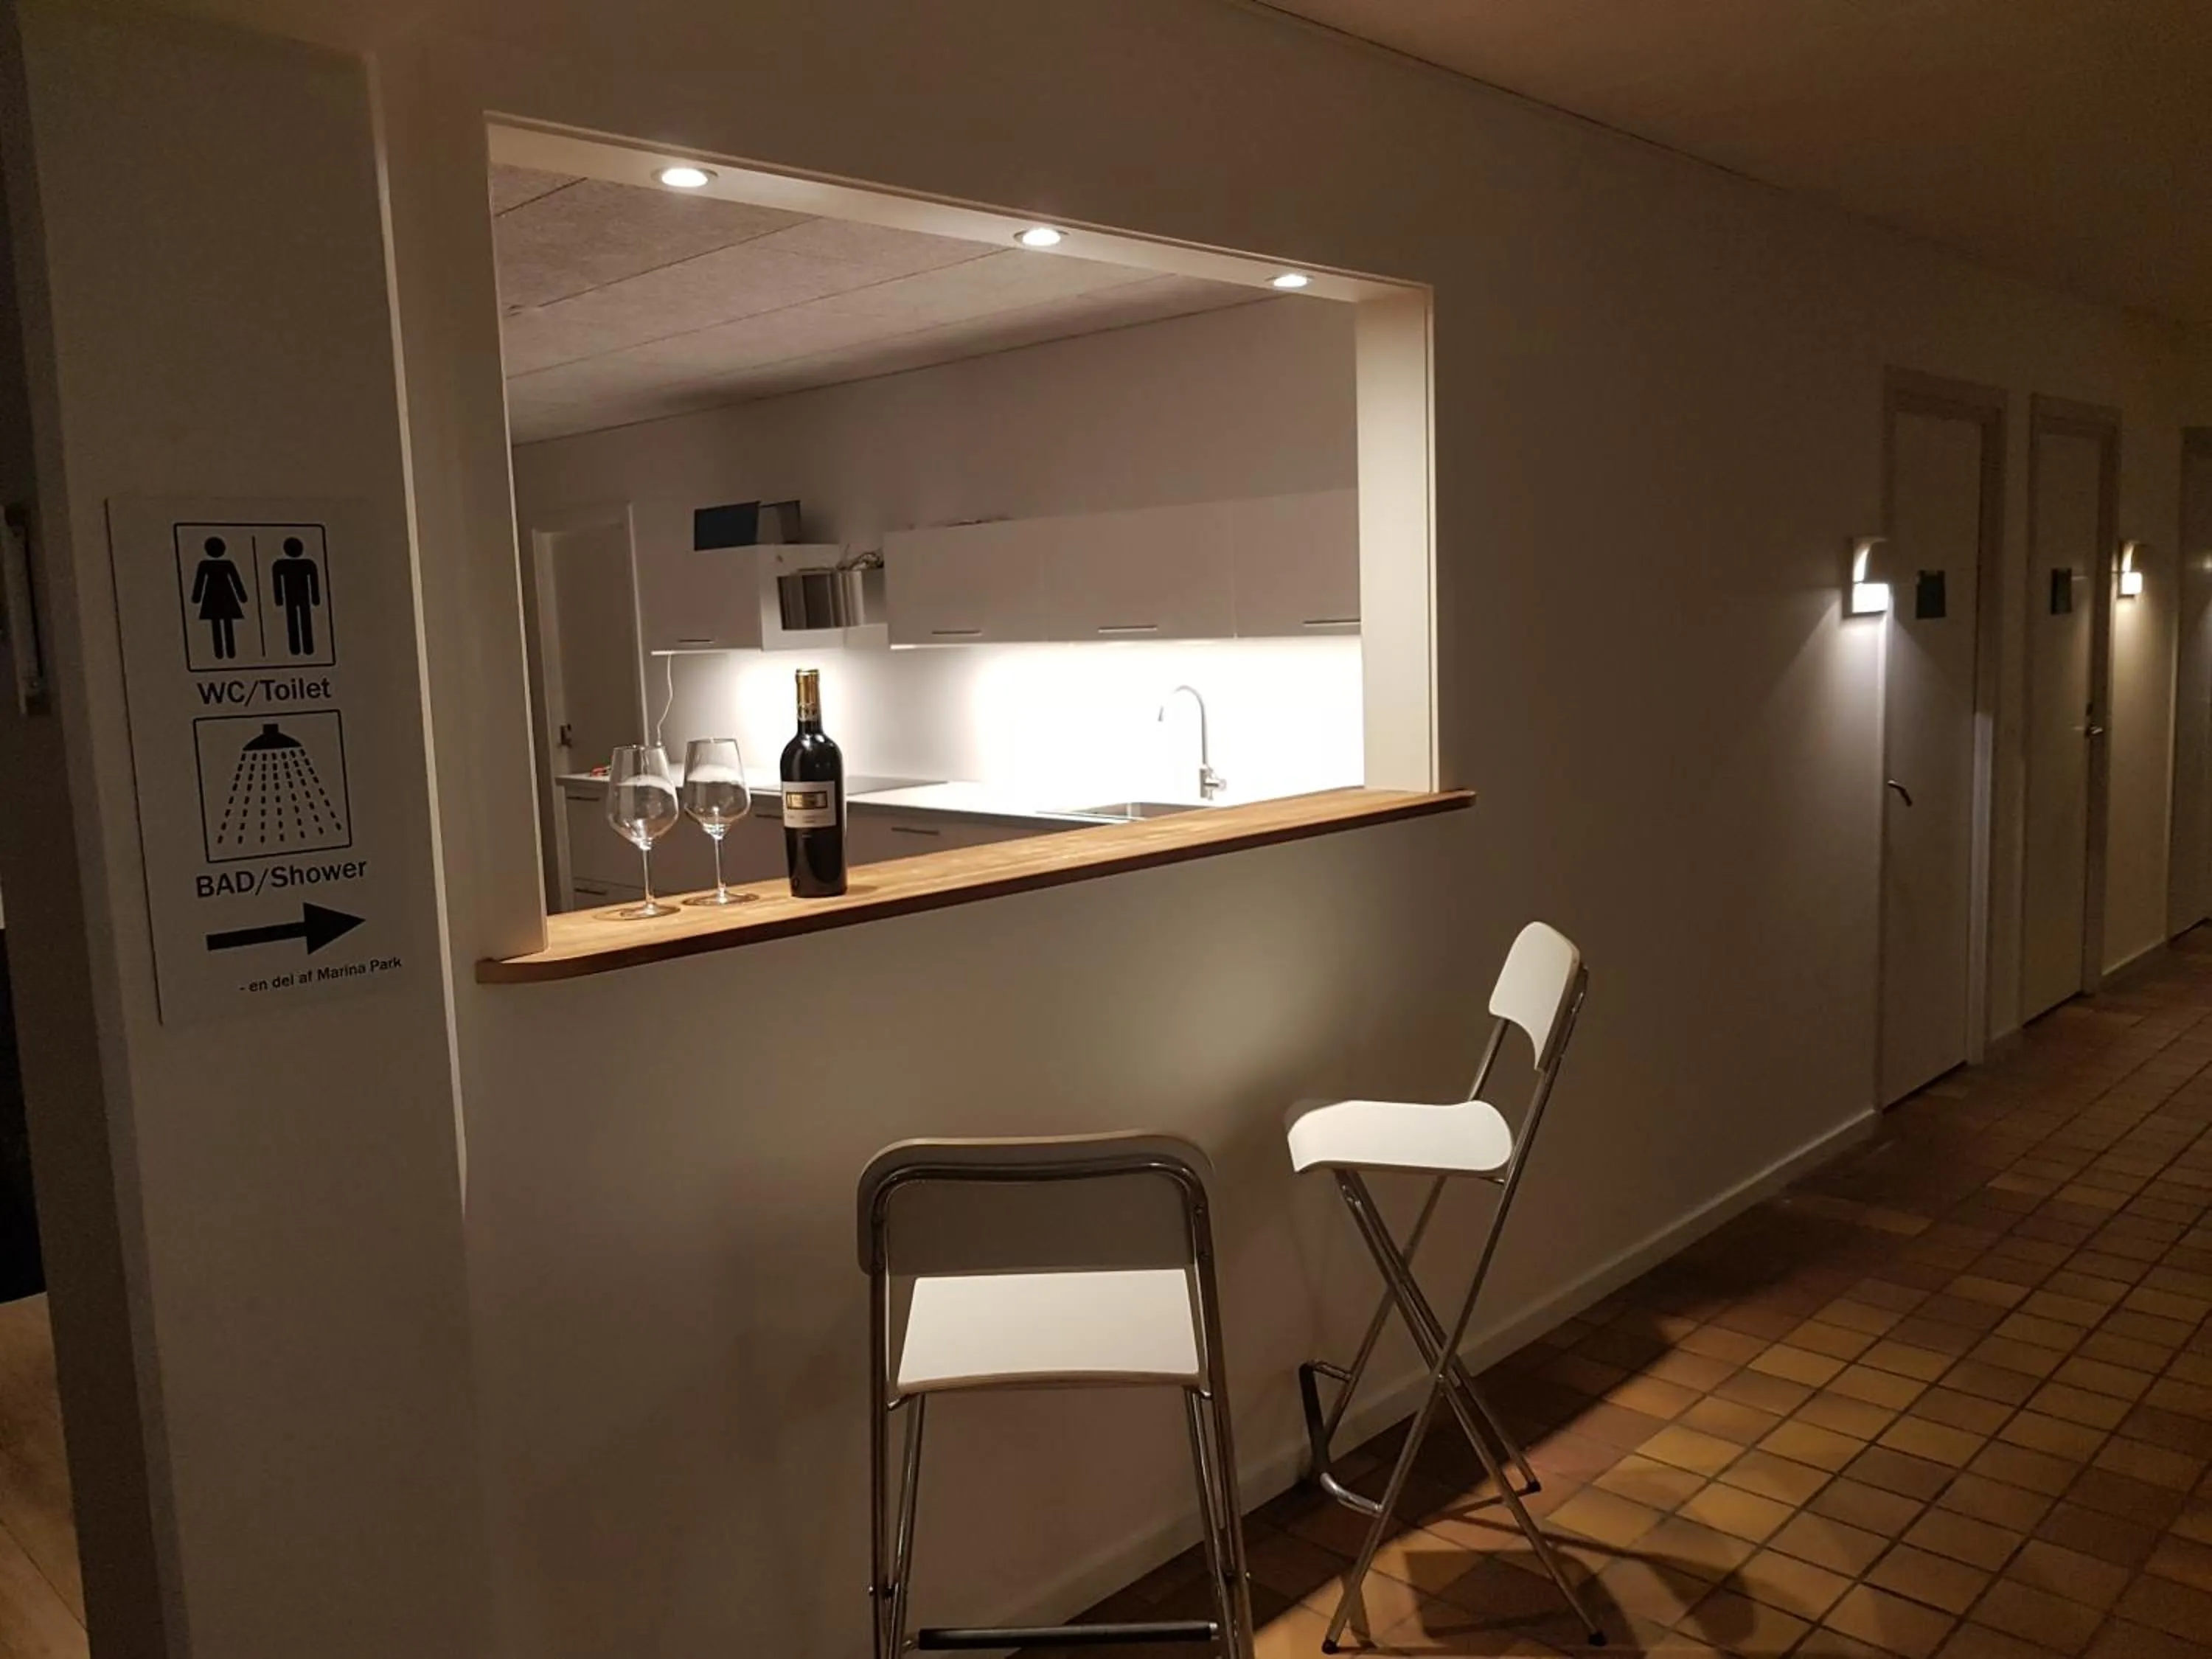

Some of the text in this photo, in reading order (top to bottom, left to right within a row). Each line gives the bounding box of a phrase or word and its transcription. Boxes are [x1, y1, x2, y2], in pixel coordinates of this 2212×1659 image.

[196, 677, 332, 707] WC/Toilet
[195, 860, 368, 899] BAD/Shower
[271, 973, 294, 989] del
[299, 966, 315, 984] af
[317, 964, 366, 981] Marina
[369, 956, 402, 973] Park
